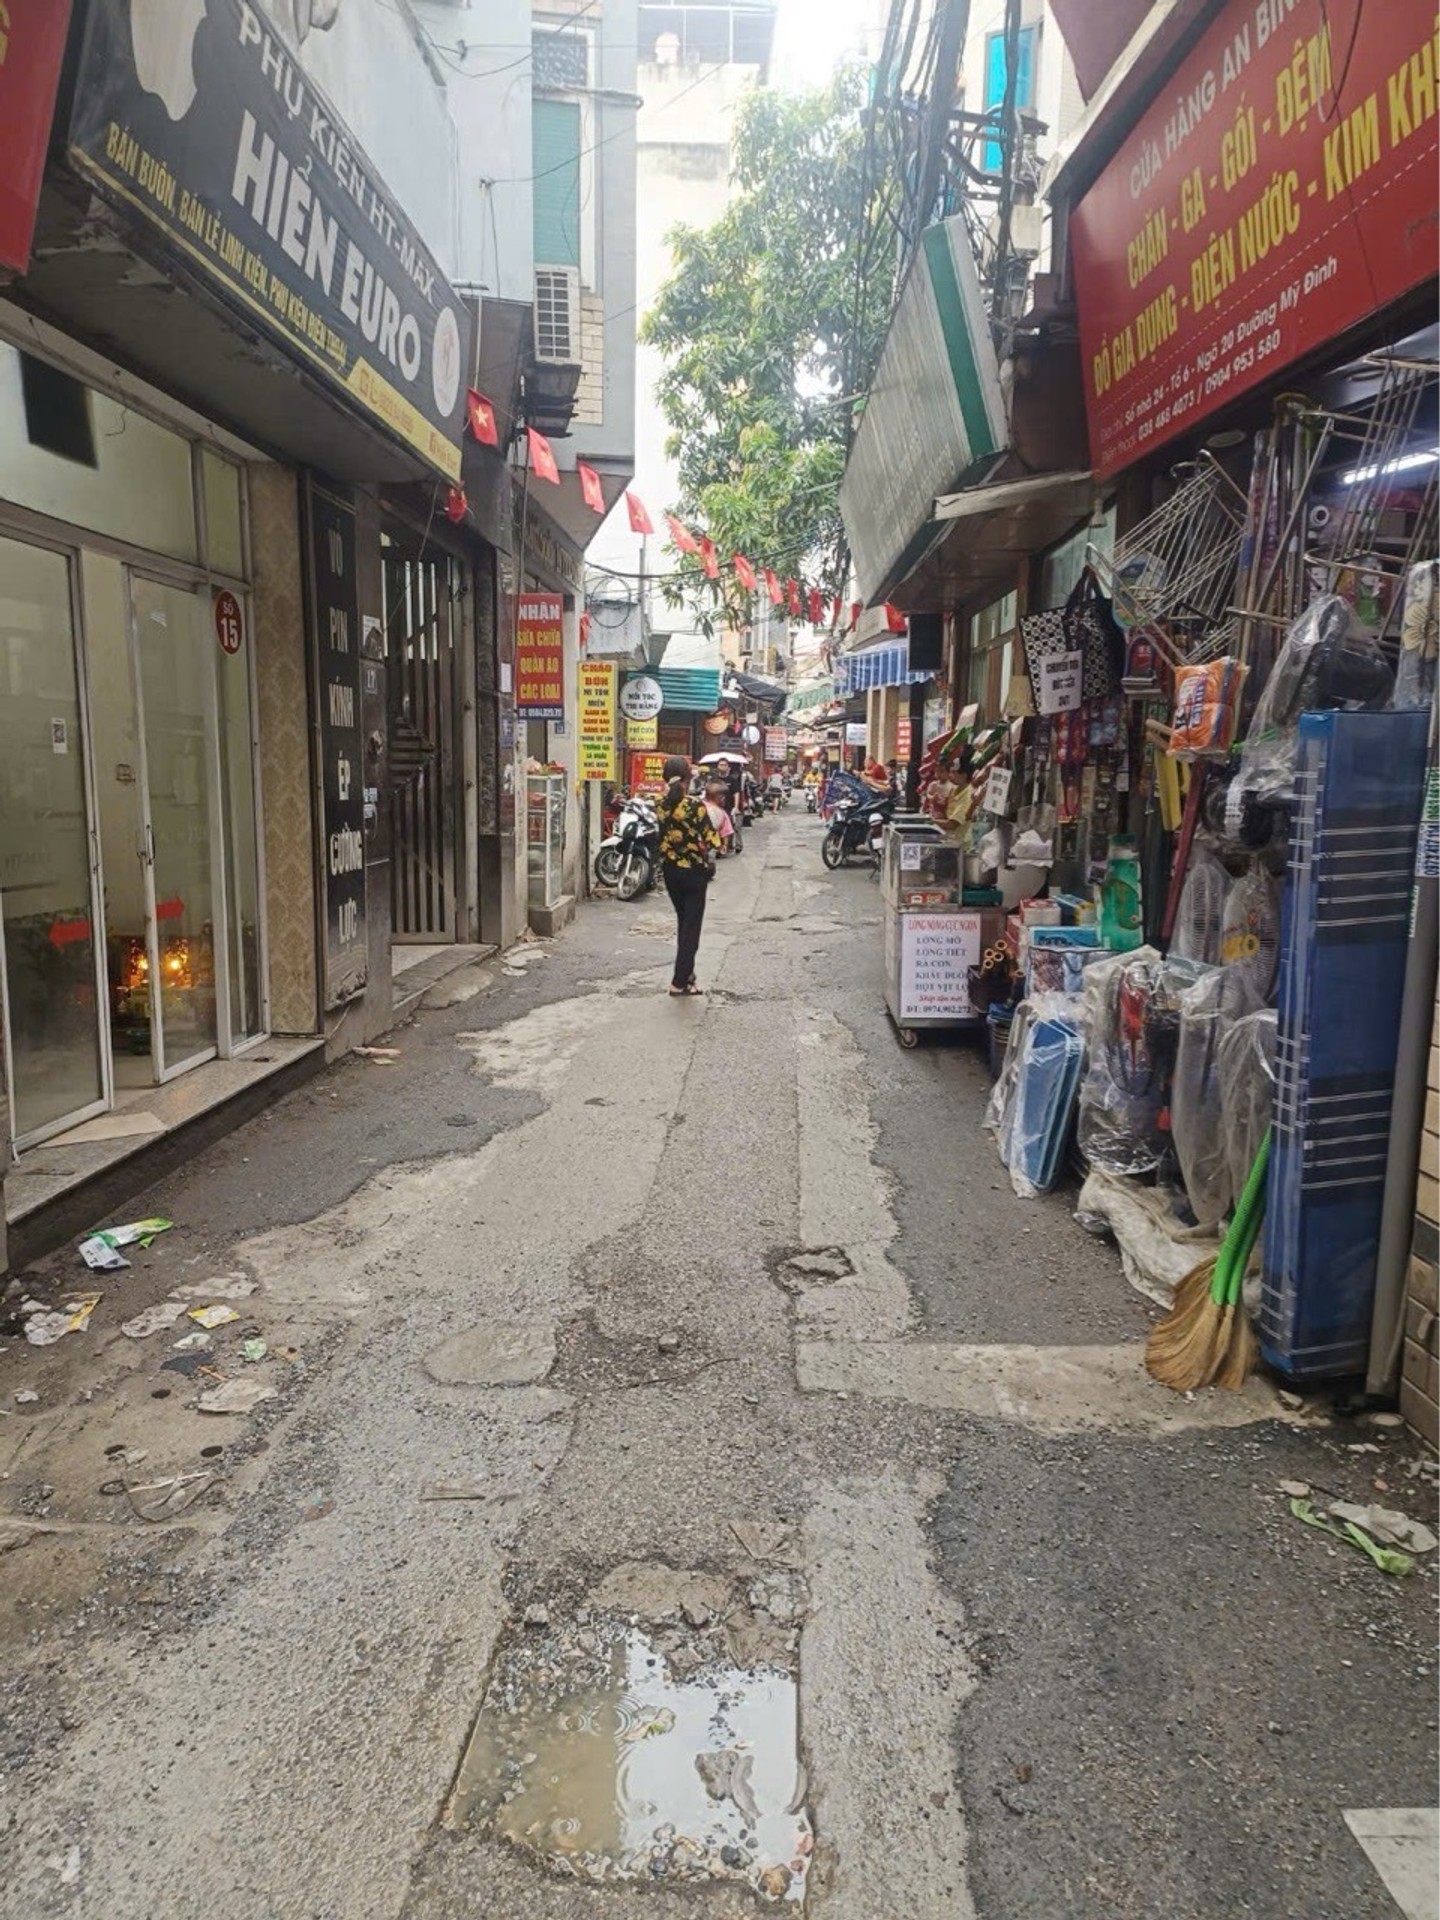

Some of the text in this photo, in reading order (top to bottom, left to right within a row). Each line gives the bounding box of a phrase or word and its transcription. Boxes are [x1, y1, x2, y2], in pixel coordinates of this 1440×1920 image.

[239, 3, 304, 120] PHỤ
[1165, 70, 1216, 158] HÀNG
[1222, 23, 1250, 93] AN
[107, 121, 139, 176] BÁN
[179, 190, 206, 237] BÁN
[1181, 166, 1206, 234] GA
[1221, 91, 1257, 192] GỐI
[232, 109, 338, 296] HIỂN
[341, 240, 421, 381] EURO
[1112, 326, 1136, 382] GIA
[1136, 284, 1178, 362] DỤNG
[1239, 170, 1301, 274] NƯỚC
[1324, 92, 1381, 202] KIM
[1221, 330, 1234, 355] 20
[220, 617, 239, 649] 15
[519, 601, 560, 623] NHẬN
